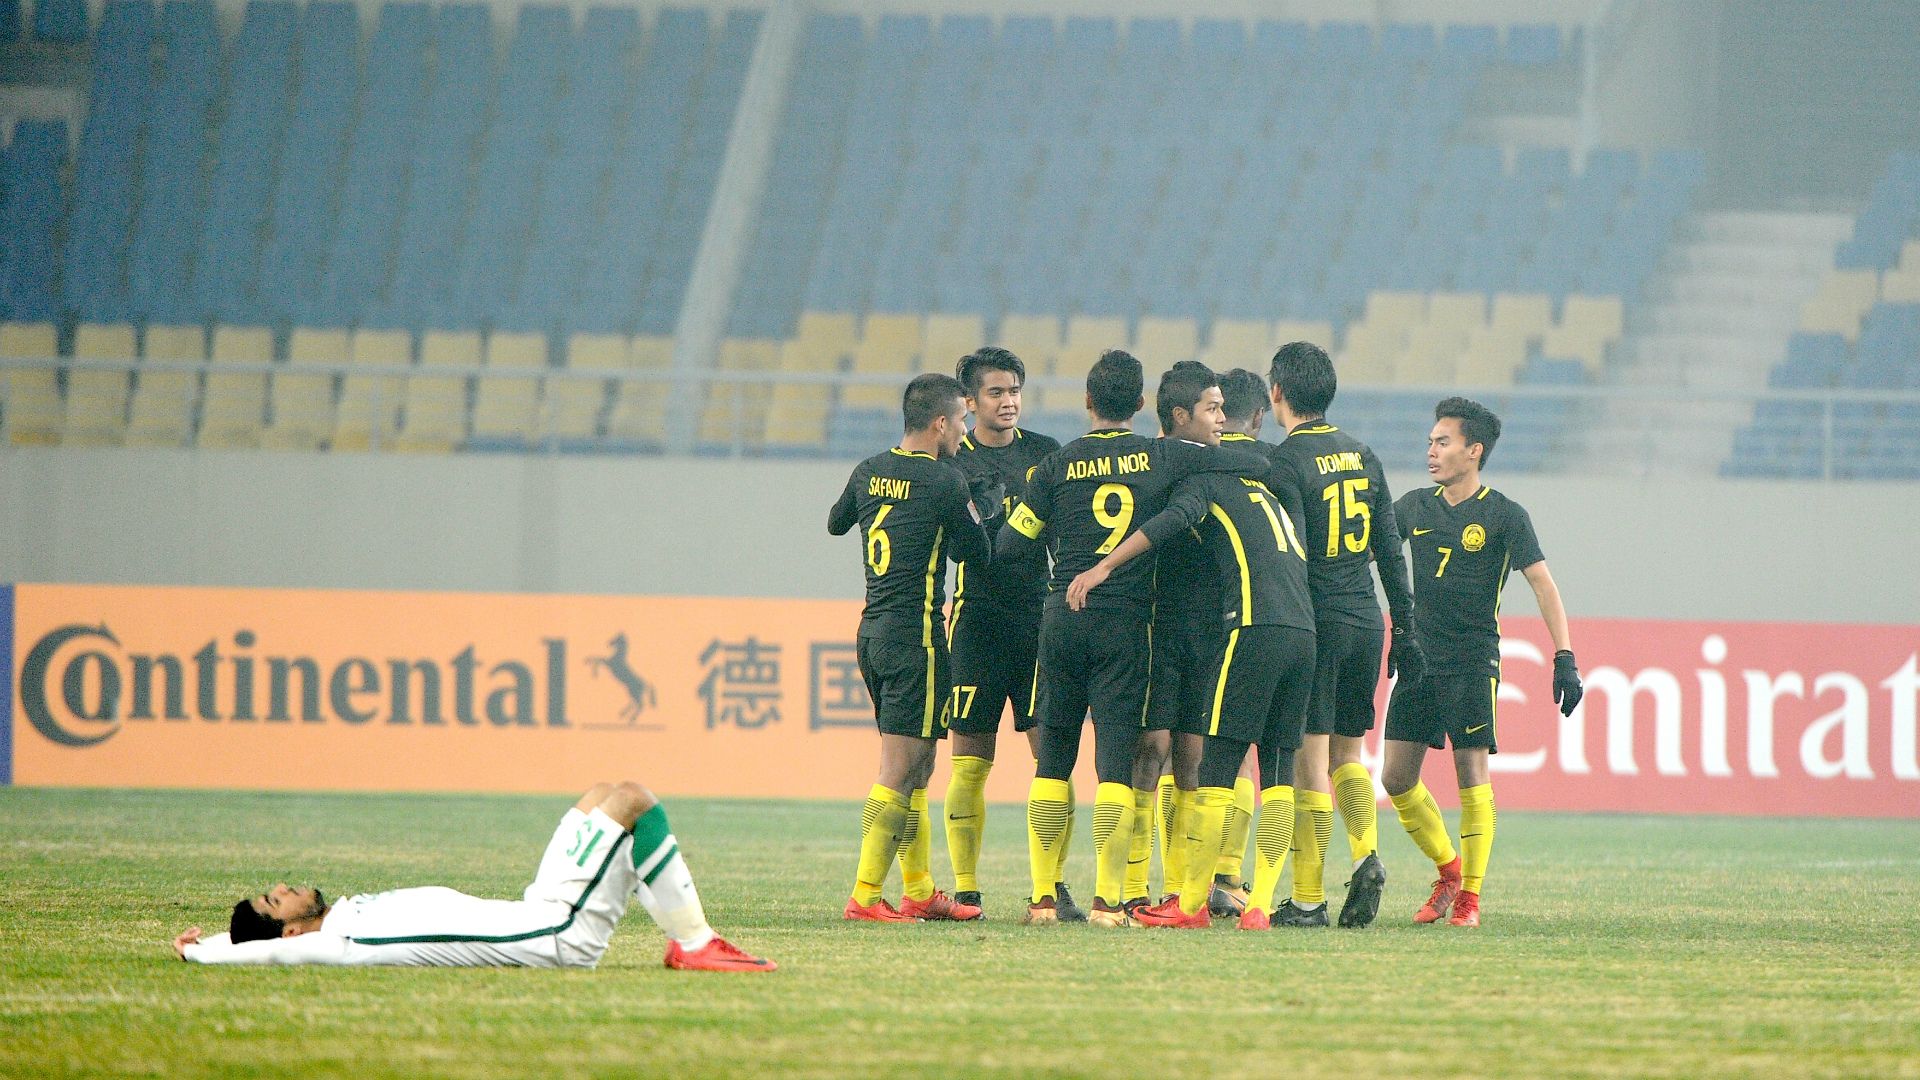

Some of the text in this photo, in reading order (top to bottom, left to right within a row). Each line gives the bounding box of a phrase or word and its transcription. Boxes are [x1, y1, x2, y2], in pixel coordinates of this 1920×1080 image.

[1065, 452, 1151, 481] ADAM NOR
[1315, 452, 1364, 475] DOMINIC
[868, 476, 911, 500] SAFAWI
[1092, 482, 1134, 555] 9
[1323, 477, 1371, 558] 15
[868, 504, 894, 576] 6
[1435, 546, 1453, 578] 7
[20, 619, 572, 748] Continental
[940, 696, 951, 729] 6
[952, 685, 978, 719] 17
